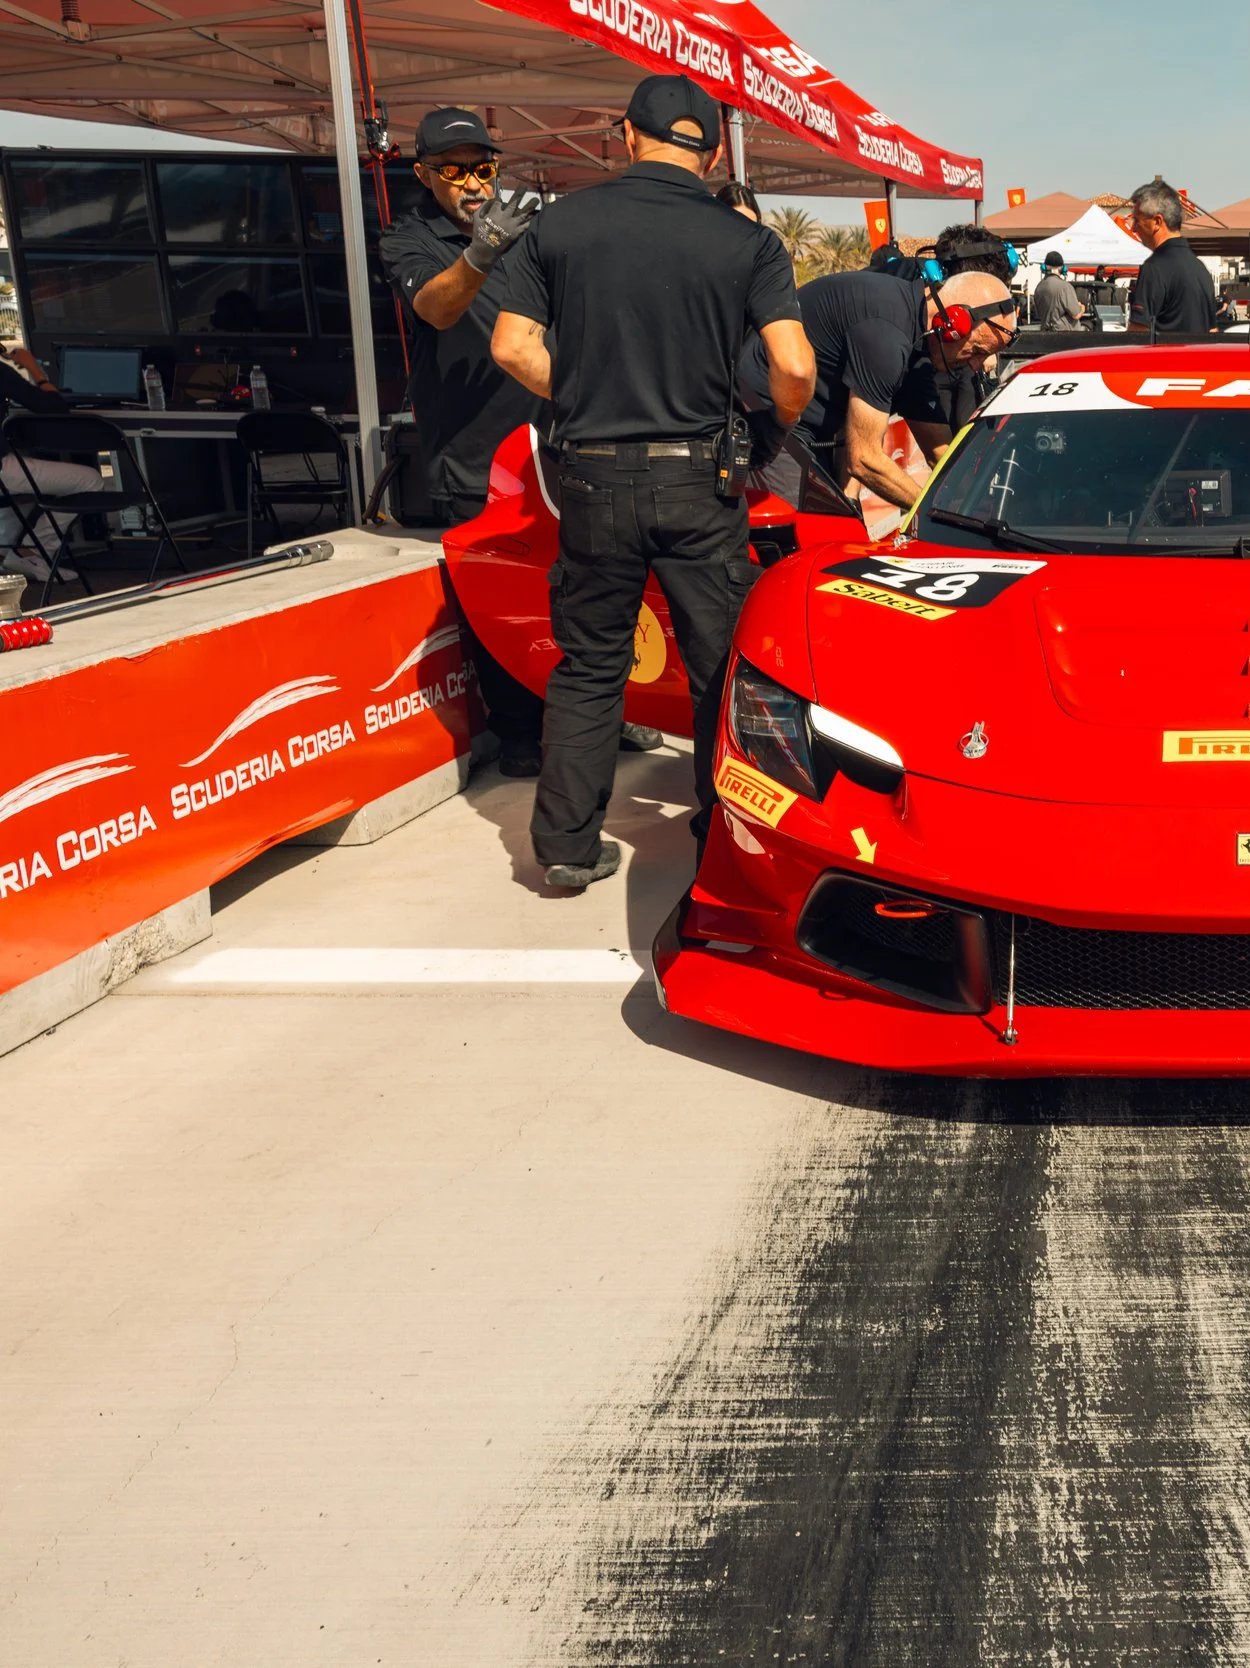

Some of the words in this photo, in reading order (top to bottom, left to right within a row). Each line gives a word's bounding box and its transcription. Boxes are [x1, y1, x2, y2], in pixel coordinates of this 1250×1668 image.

[672, 18, 735, 86] CORSA
[743, 53, 804, 123] SCUDERIA
[801, 92, 840, 142] CORSA
[854, 124, 901, 169] SCUDERIA
[898, 140, 925, 177] CORSA
[1028, 382, 1080, 398] 18
[834, 583, 936, 616] Sabelt
[860, 568, 981, 601] 18
[364, 684, 445, 738] SCUDERIA
[171, 750, 287, 821] SCUDERIA
[287, 720, 356, 769] CORSA
[719, 764, 785, 816] PIRELLI
[56, 805, 157, 871] CORSA
